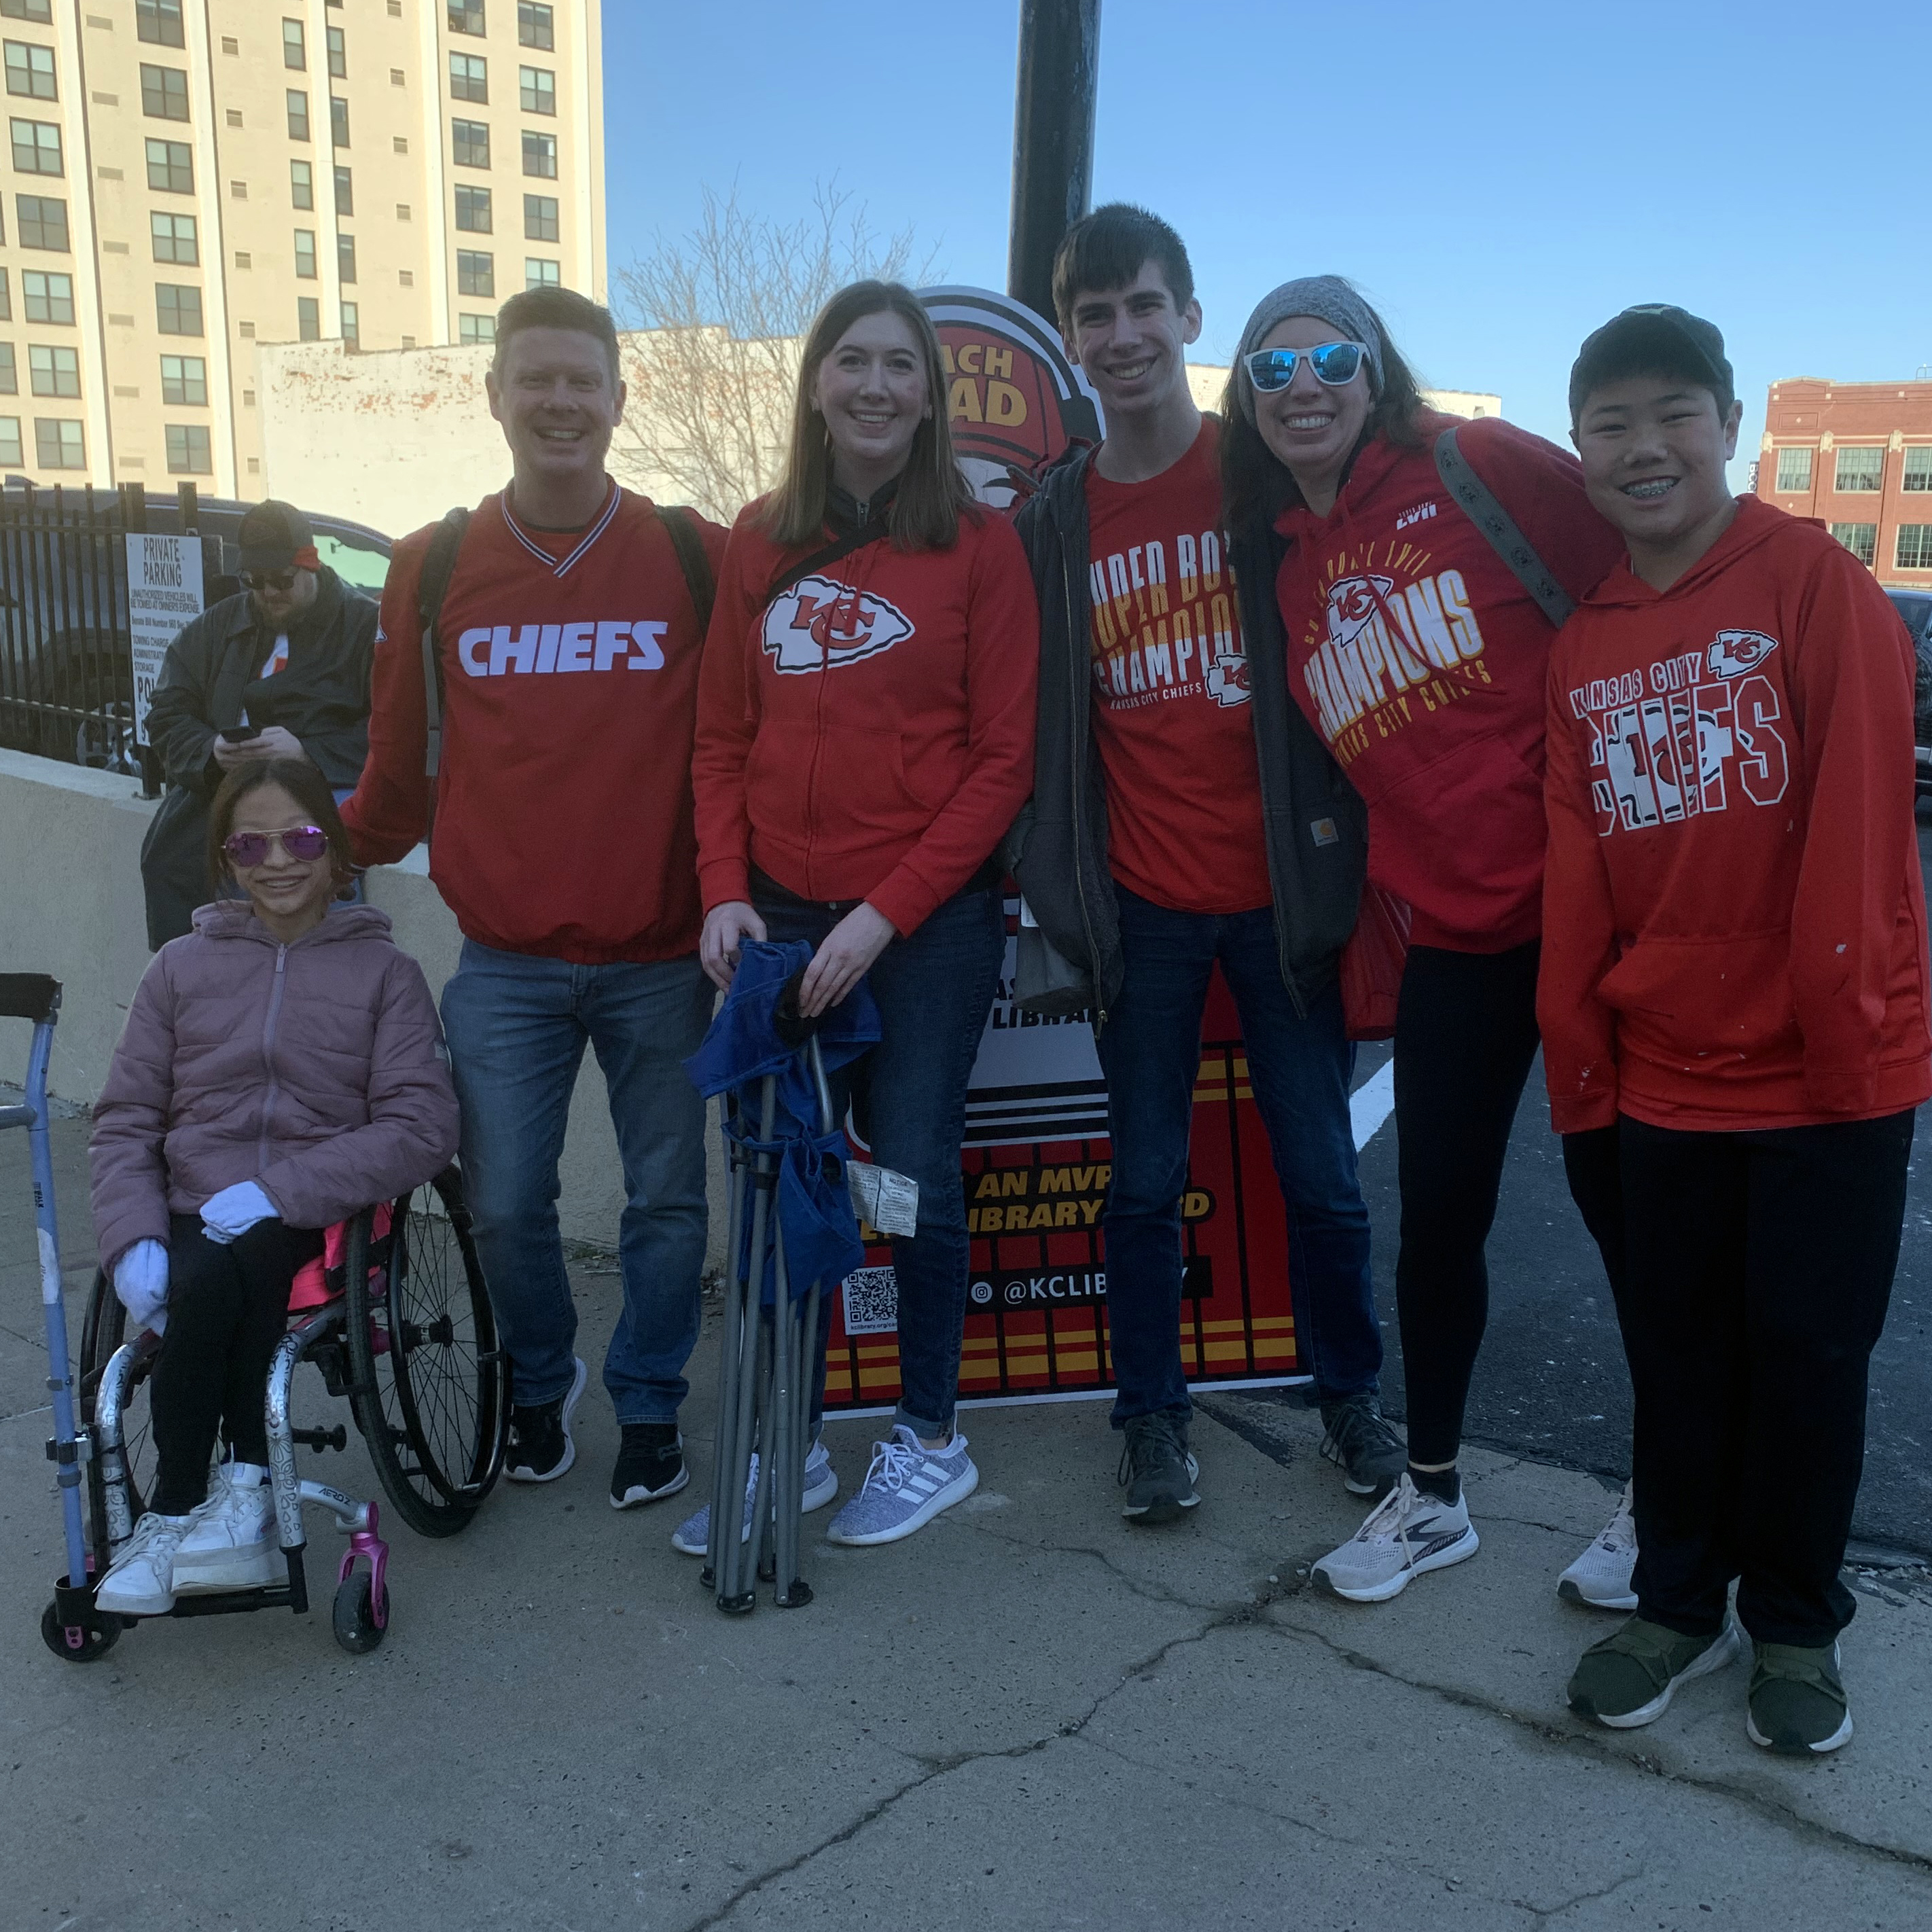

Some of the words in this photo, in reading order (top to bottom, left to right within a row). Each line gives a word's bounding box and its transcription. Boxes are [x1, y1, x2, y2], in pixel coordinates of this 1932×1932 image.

[949, 377, 1027, 427] AD
[143, 537, 181, 562] PRIVATE
[143, 561, 182, 588] PARKING
[130, 598, 137, 608] BE
[137, 598, 152, 609] TOWED
[153, 600, 158, 610] AT
[179, 603, 200, 614] EXPENSE
[131, 588, 164, 601] UNAUTHORIZED
[164, 591, 185, 602] VEHICLES
[186, 592, 198, 603] WILL
[1089, 541, 1169, 649] UPER
[789, 594, 876, 650] KC
[133, 634, 149, 645] TOWING
[458, 621, 668, 677] CHIEFS
[1723, 637, 1761, 664] KC
[135, 661, 155, 674] STORAGE
[1110, 694, 1139, 710] KANSAS
[1141, 692, 1159, 705] CITY
[1162, 682, 1202, 700] CHIEFS
[889, 1177, 908, 1187] NOTICE
[974, 1170, 1028, 1198] AN
[1039, 1165, 1112, 1194] MVP
[968, 1199, 1104, 1232] IBRARY
[1004, 1272, 1107, 1305] @KCLIB
[319, 1488, 344, 1502] AERO
